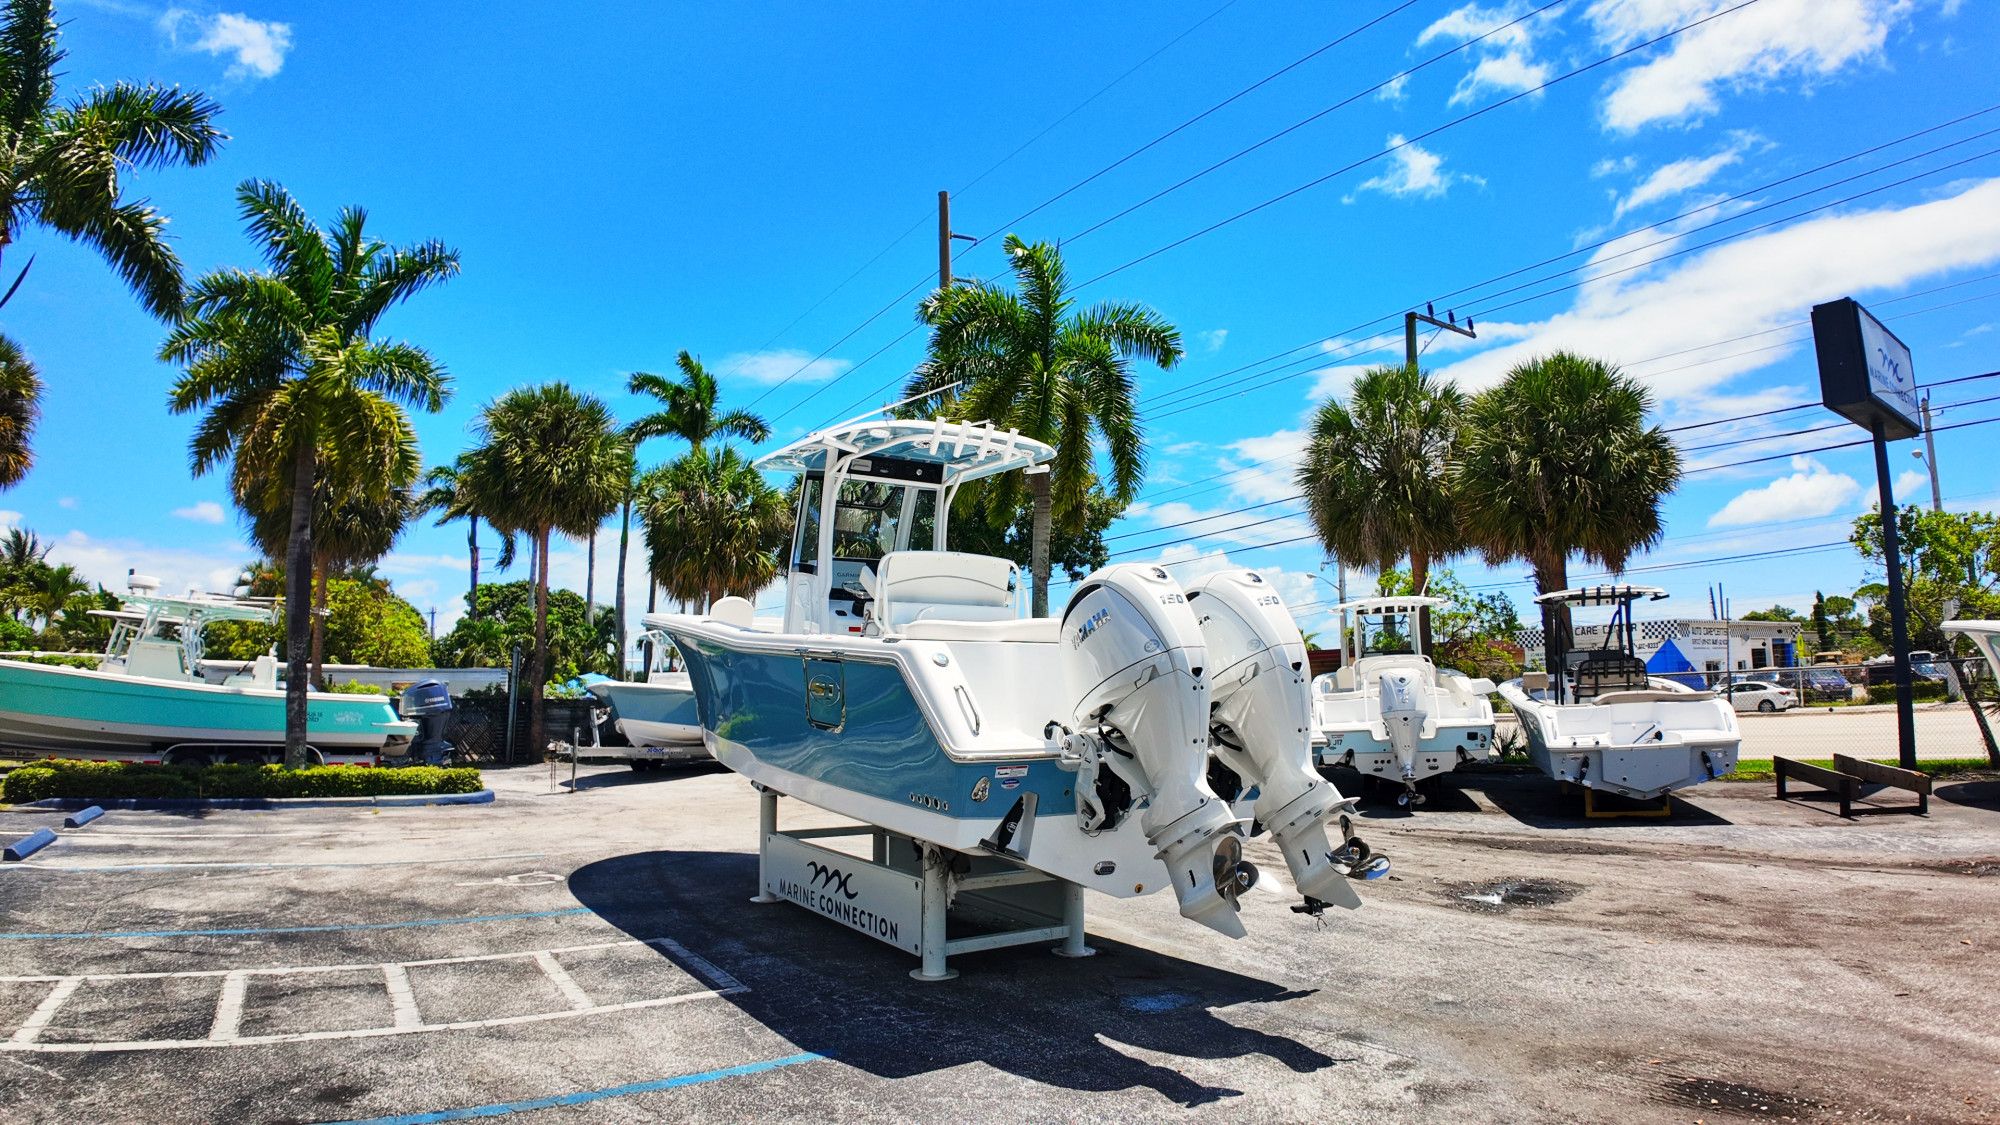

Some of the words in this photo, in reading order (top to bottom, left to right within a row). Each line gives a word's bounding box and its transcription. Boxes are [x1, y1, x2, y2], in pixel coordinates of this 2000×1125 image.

[1159, 593, 1184, 605] 150
[1257, 595, 1280, 606] 150
[1071, 607, 1112, 650] YAMAHA
[1574, 625, 1598, 636] CARE
[779, 878, 815, 908] MARINE
[819, 894, 898, 941] CONNECTION
